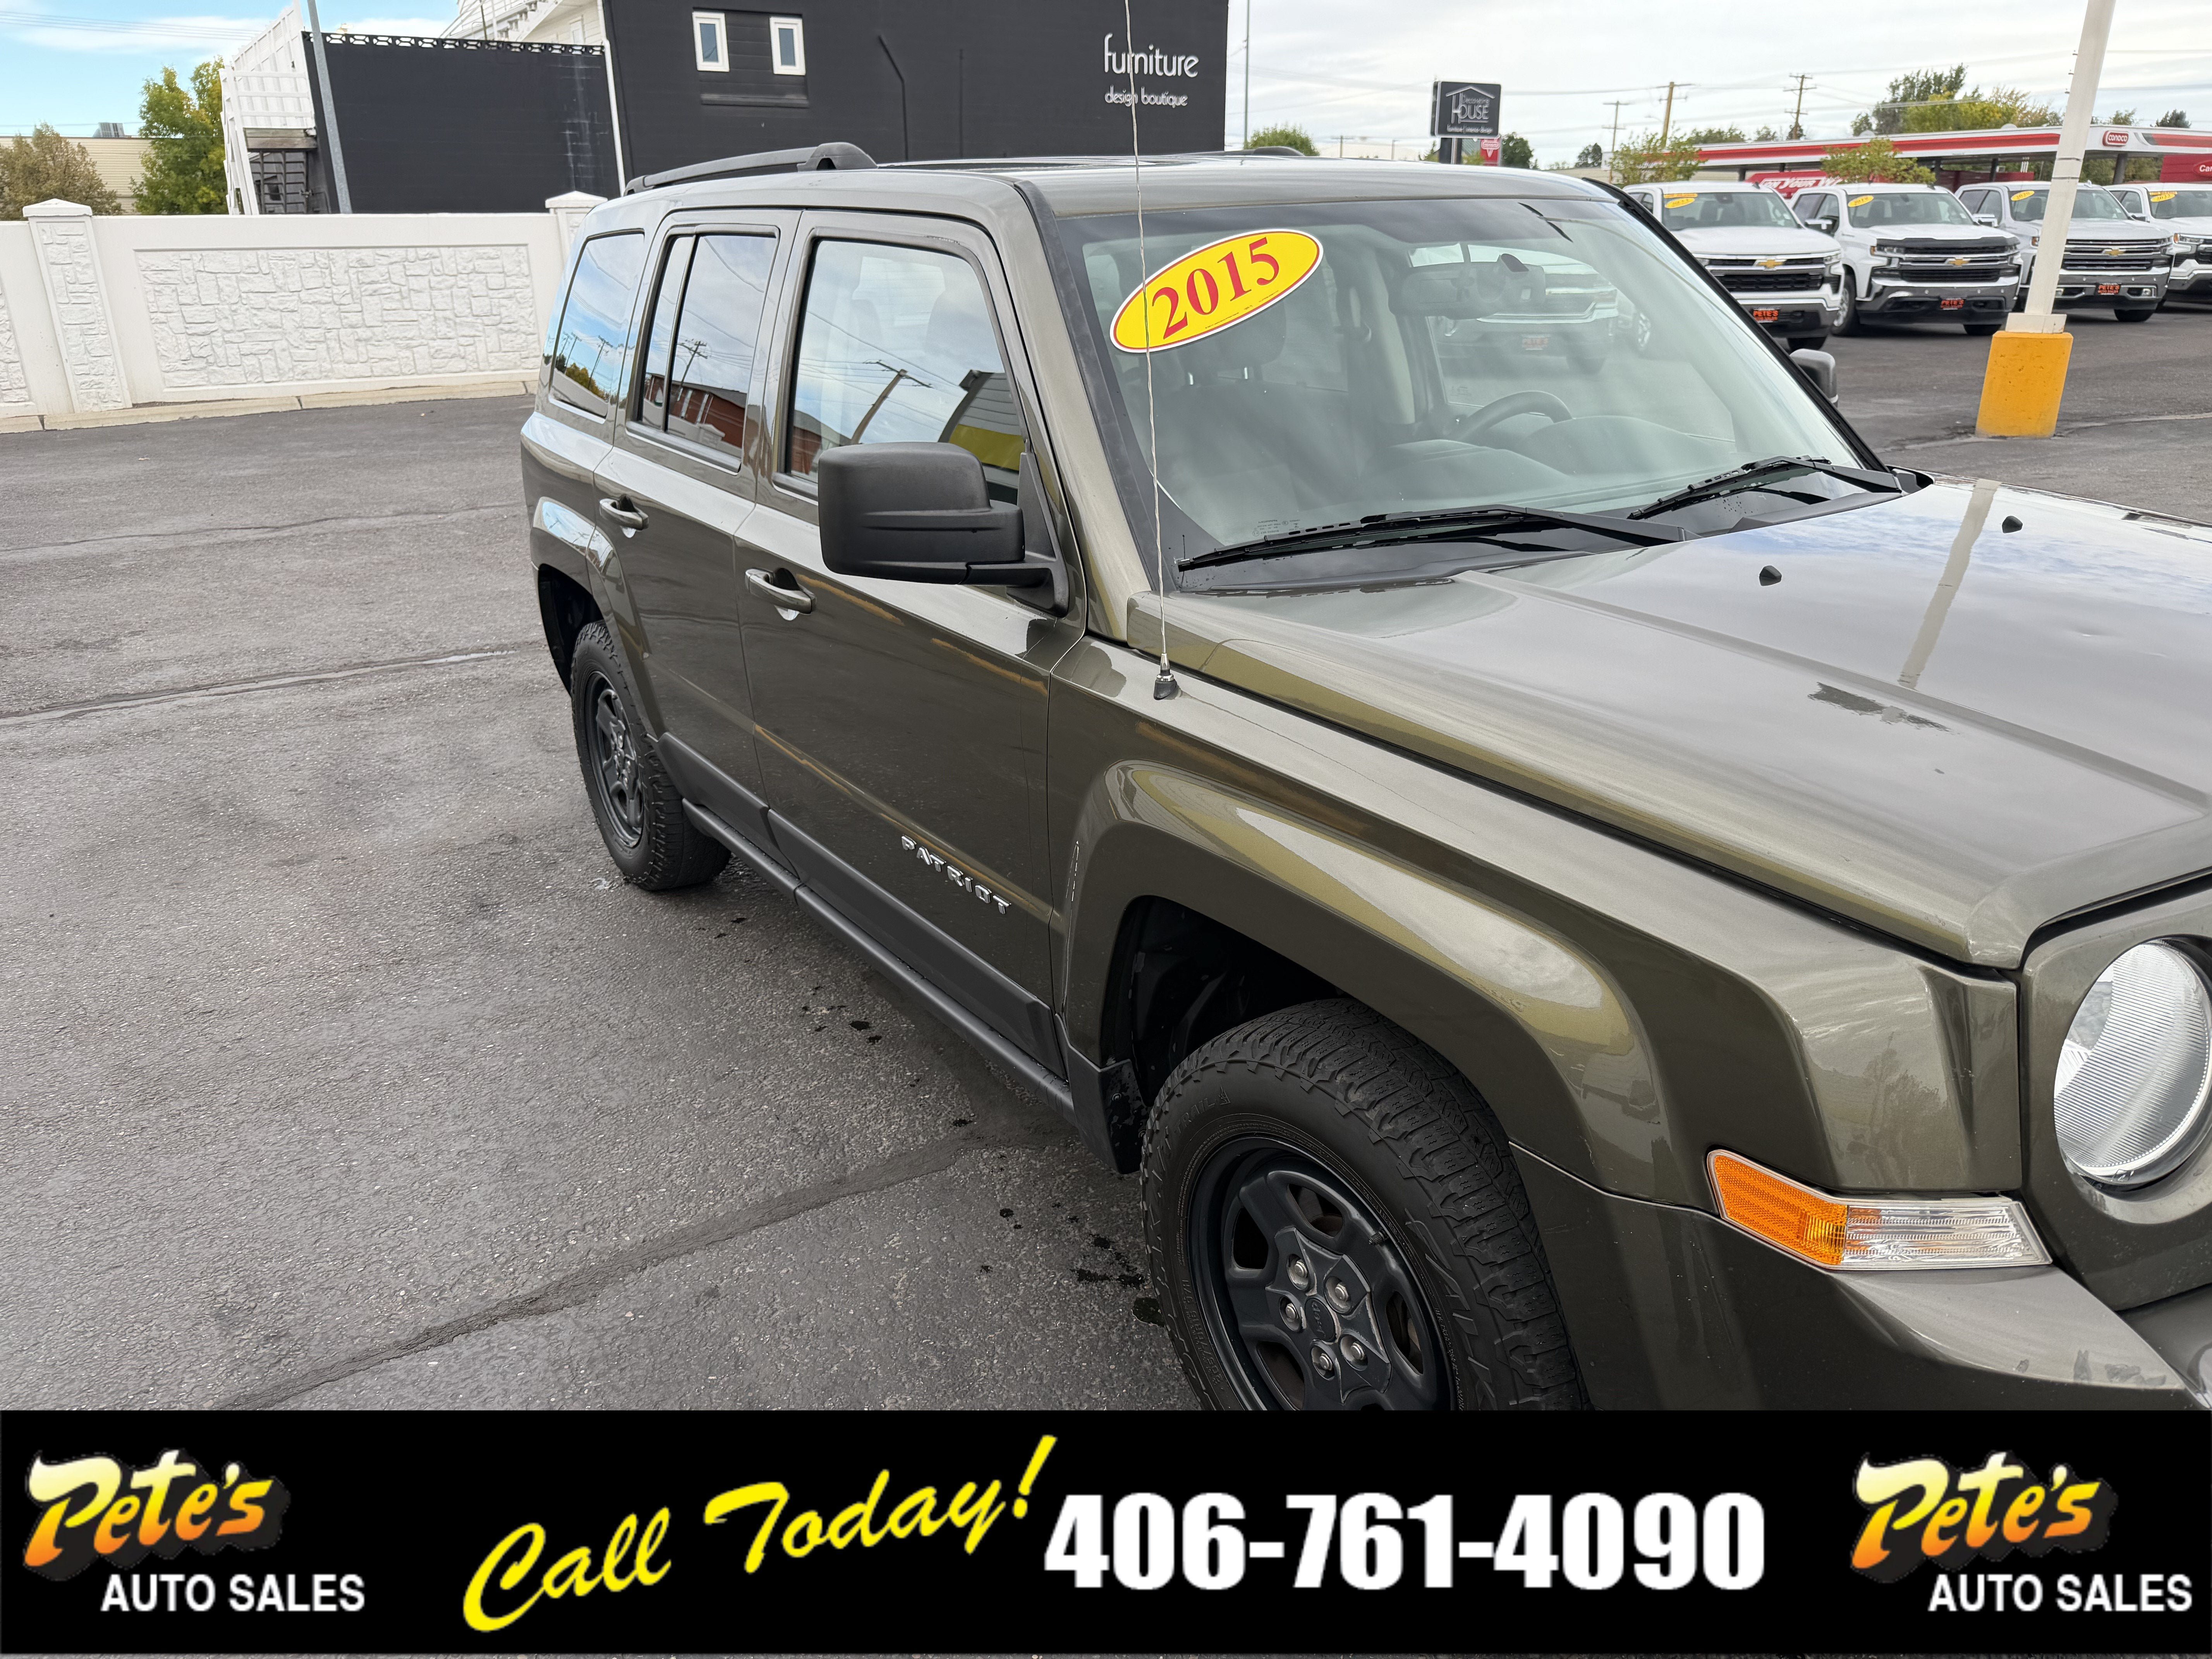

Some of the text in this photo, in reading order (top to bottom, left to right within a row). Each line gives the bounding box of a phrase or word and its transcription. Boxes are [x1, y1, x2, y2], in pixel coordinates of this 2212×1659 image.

[1104, 33, 1199, 77] furniture
[1105, 84, 1188, 108] design boutique
[1152, 237, 1279, 339] 2015
[902, 835, 1013, 914] PATRIOT
